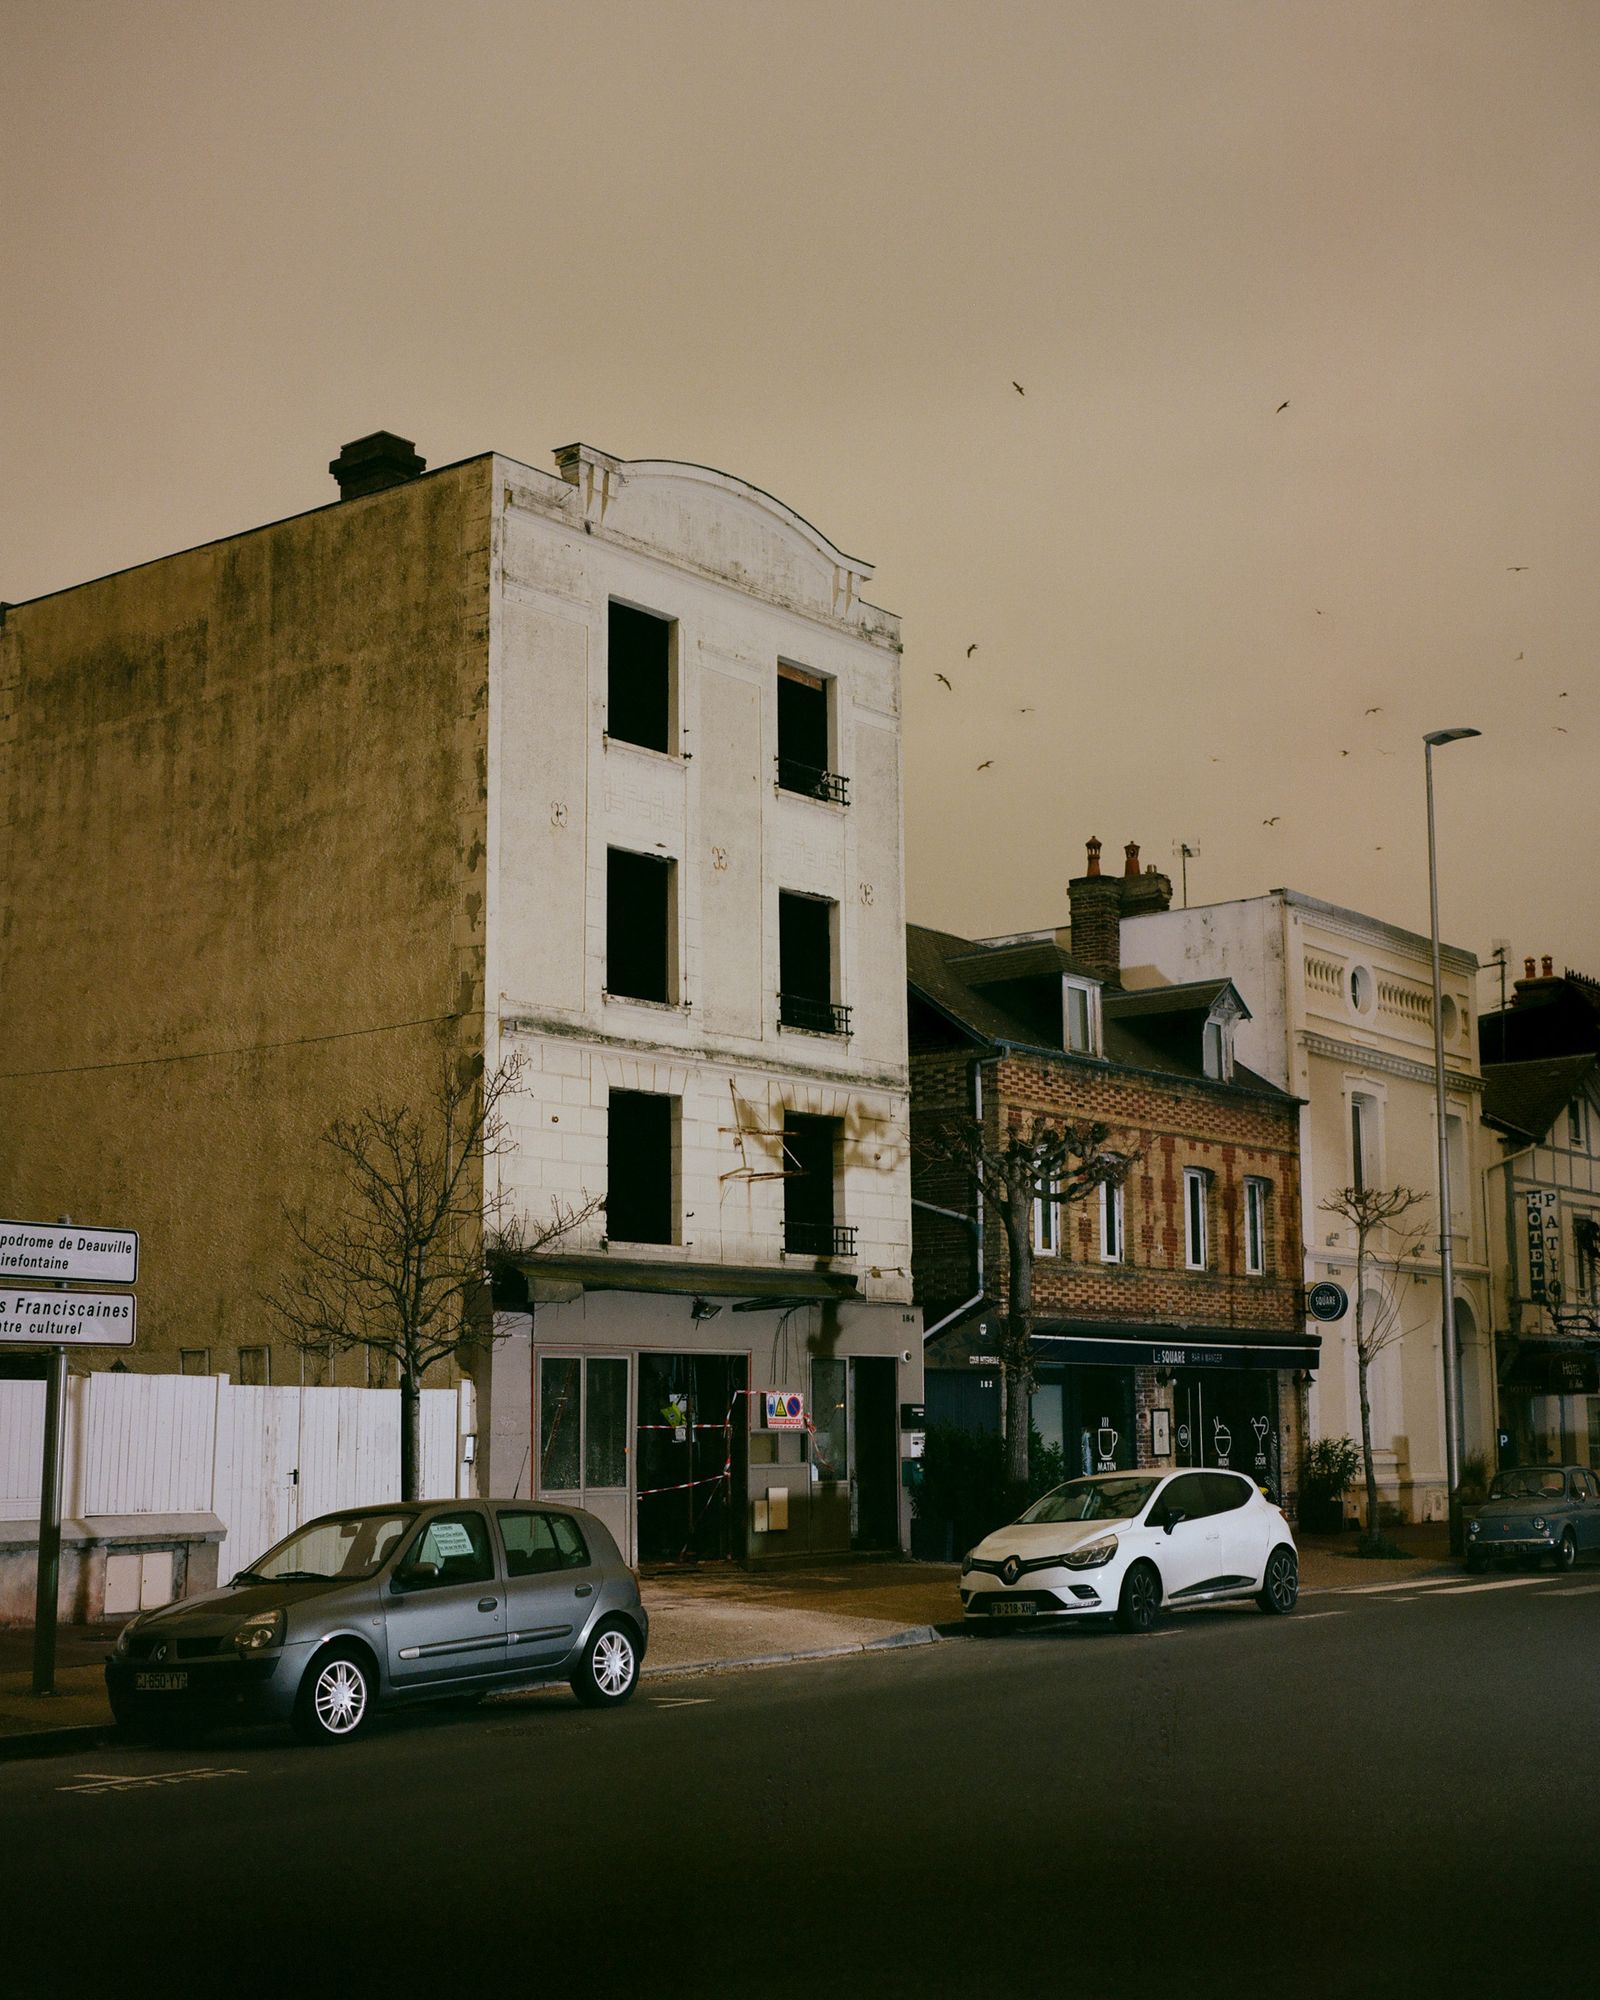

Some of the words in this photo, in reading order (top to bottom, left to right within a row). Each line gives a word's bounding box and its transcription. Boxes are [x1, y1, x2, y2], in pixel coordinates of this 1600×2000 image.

[59, 1237, 73, 1250] de
[77, 1238, 132, 1254] Deauville
[1544, 1193, 1561, 1297] PATIO
[0, 1253, 69, 1270] irefontaine
[1315, 1295, 1336, 1306] SQUARE
[15, 1298, 129, 1318] Franciscaines
[902, 1314, 915, 1323] 184
[0, 1321, 22, 1333] tre
[29, 1320, 83, 1335] culturel
[1161, 1349, 1186, 1364] SQUARE
[980, 1379, 993, 1389] 182
[1500, 1434, 1509, 1447] P
[1096, 1461, 1117, 1472] MATIN
[1217, 1457, 1230, 1466] MIDI
[1254, 1456, 1267, 1466] SOIR
